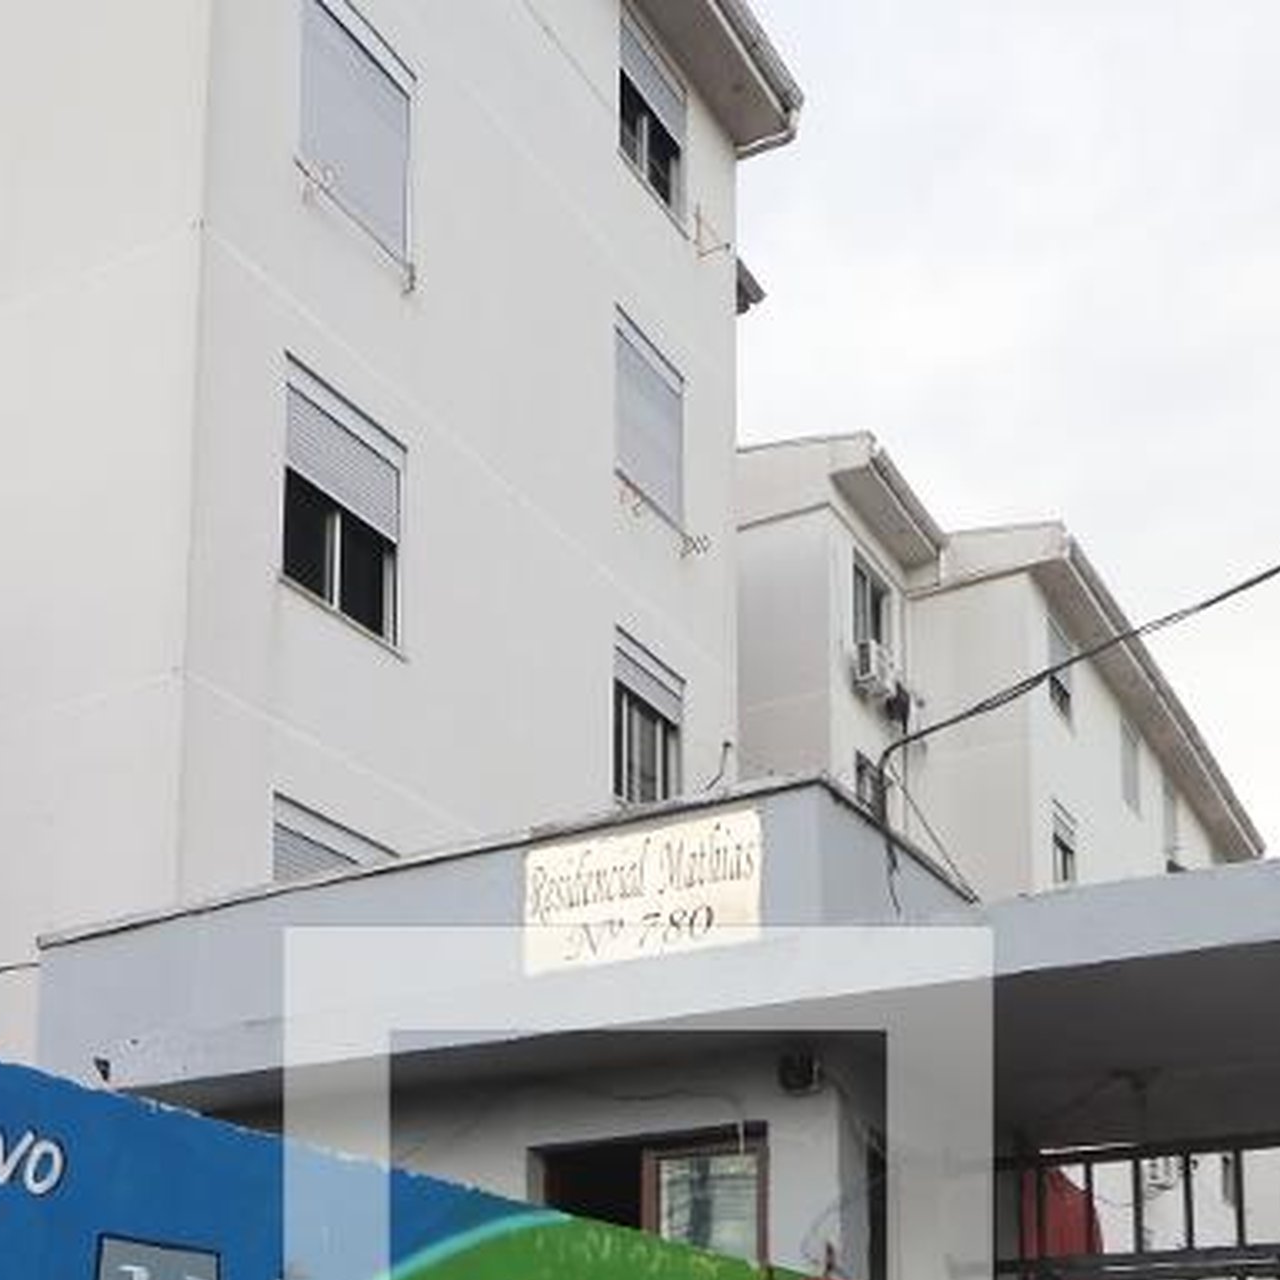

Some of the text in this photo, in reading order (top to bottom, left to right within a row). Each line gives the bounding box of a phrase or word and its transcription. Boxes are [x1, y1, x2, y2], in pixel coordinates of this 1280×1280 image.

[530, 822, 755, 926] Residencial Mathias
[638, 904, 714, 948] 780
